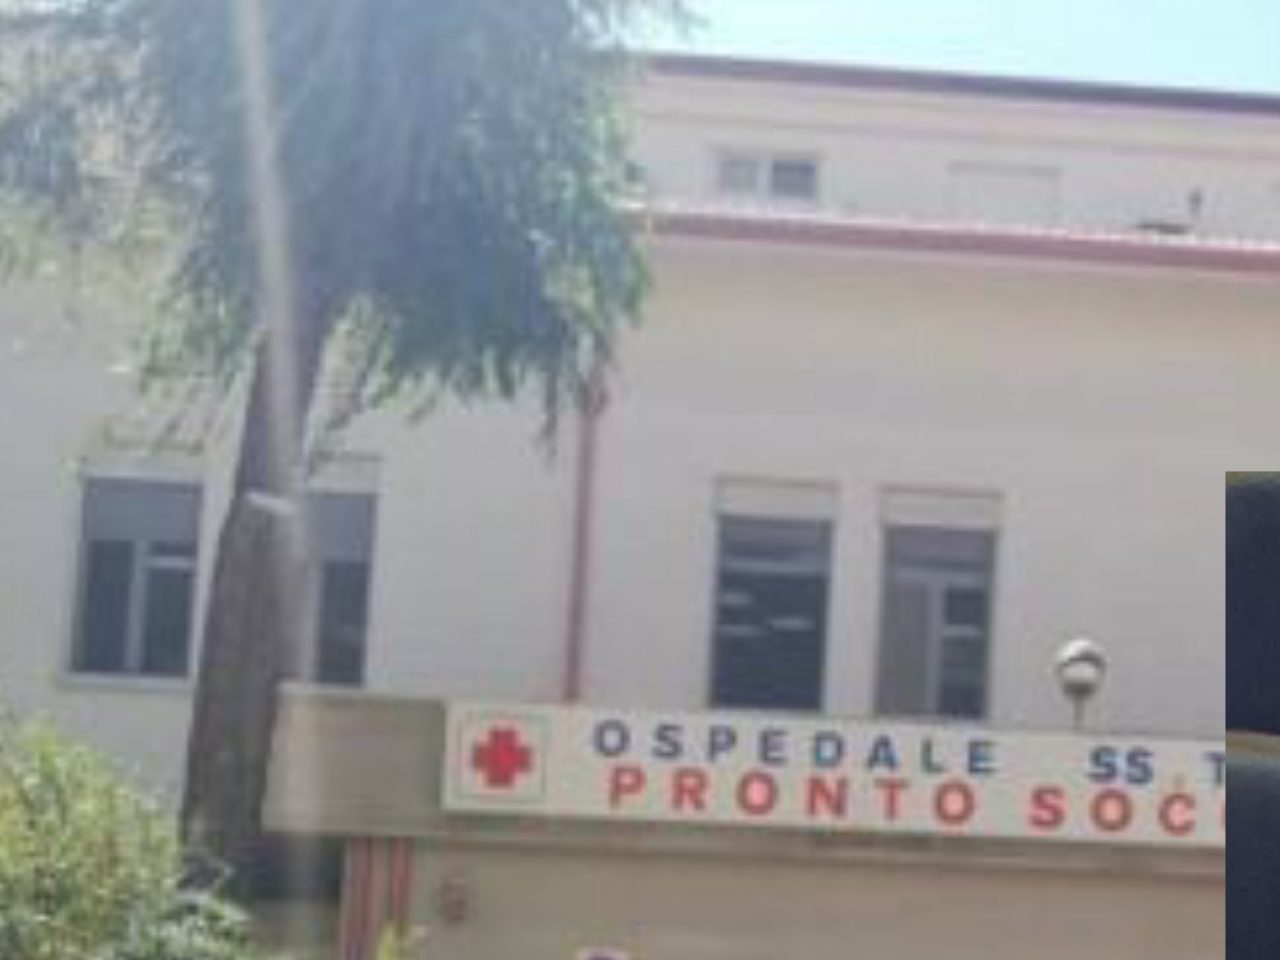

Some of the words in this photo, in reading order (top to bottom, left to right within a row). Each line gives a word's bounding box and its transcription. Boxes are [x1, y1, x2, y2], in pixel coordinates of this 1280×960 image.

[593, 719, 998, 775] OSPEDALE
[608, 765, 976, 826] PRONTO
[1029, 785, 1225, 837] SOC
